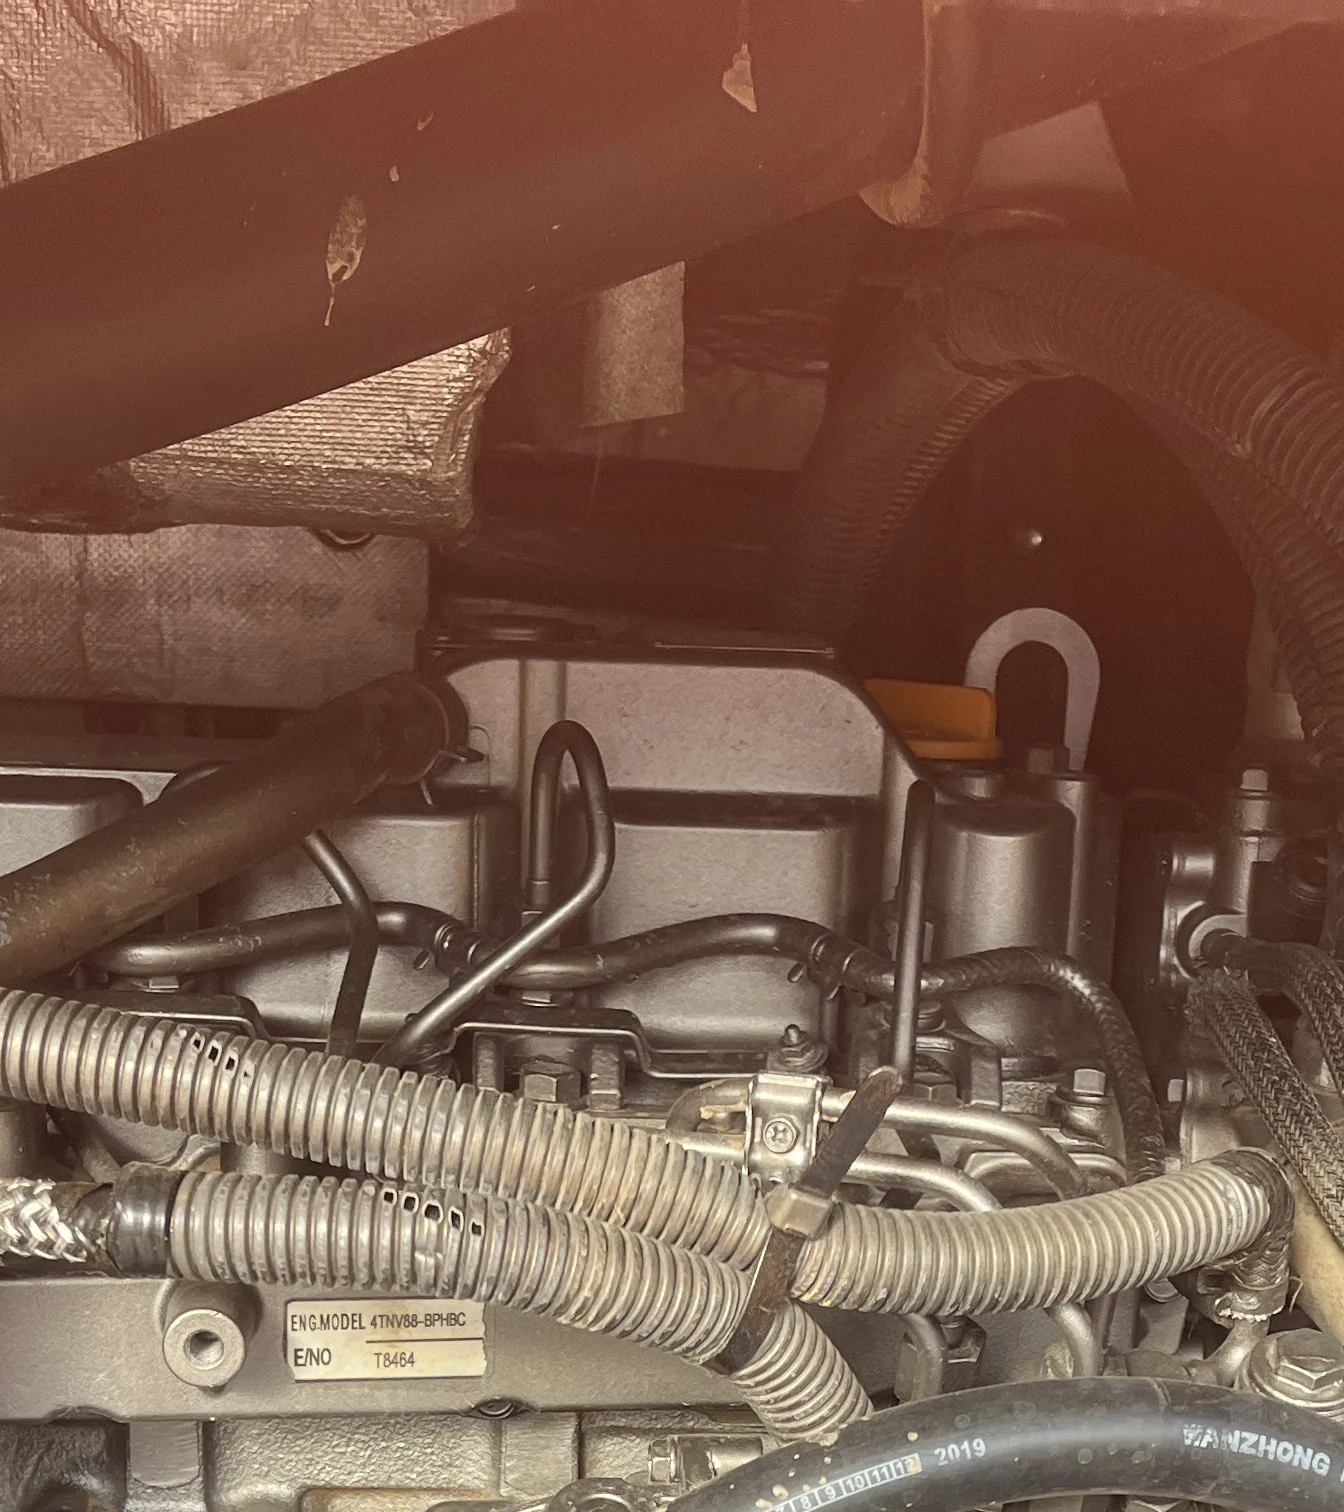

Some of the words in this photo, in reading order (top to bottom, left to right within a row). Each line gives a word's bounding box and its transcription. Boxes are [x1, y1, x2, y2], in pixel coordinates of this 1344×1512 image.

[294, 1347, 332, 1367] E/NO
[374, 1351, 415, 1368] T8464
[933, 1437, 986, 1467] 2019
